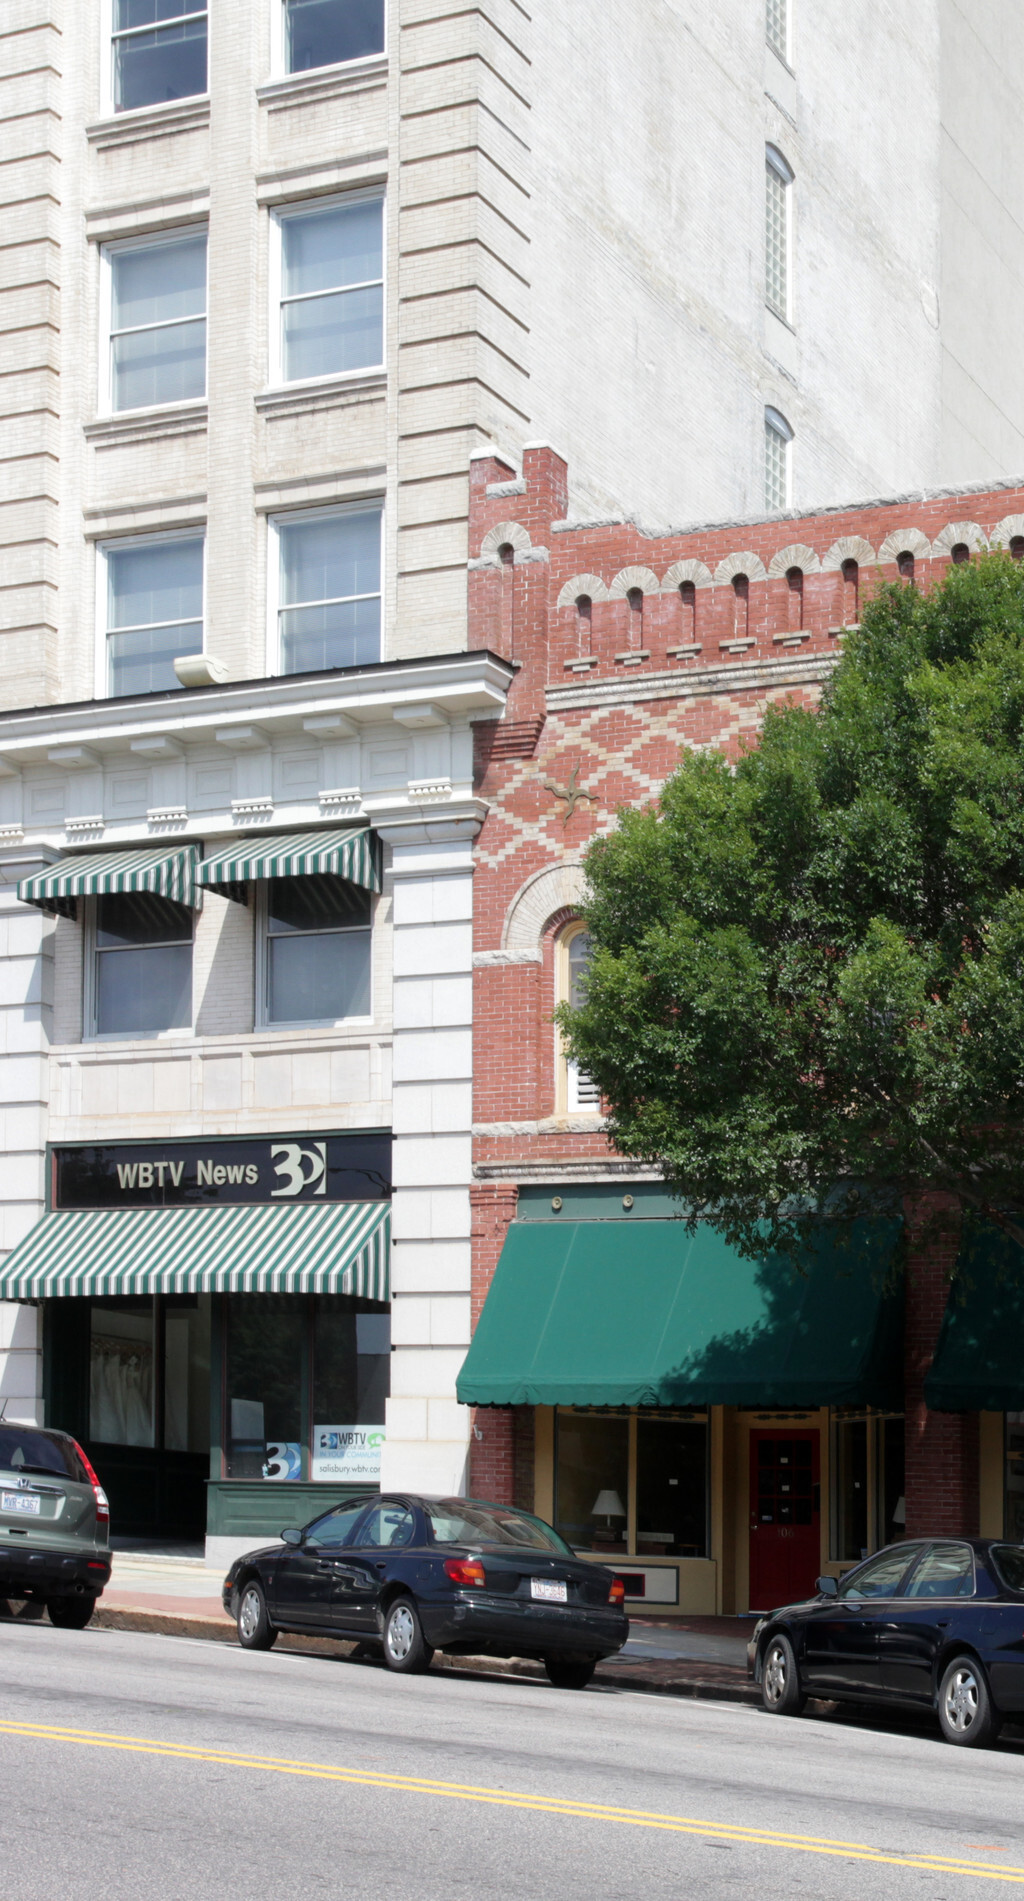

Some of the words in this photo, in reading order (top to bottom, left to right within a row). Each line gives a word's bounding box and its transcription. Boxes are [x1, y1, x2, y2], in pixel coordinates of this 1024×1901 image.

[117, 1161, 184, 1189] WBTV
[197, 1160, 259, 1186] News
[338, 1432, 366, 1445] WBTV
